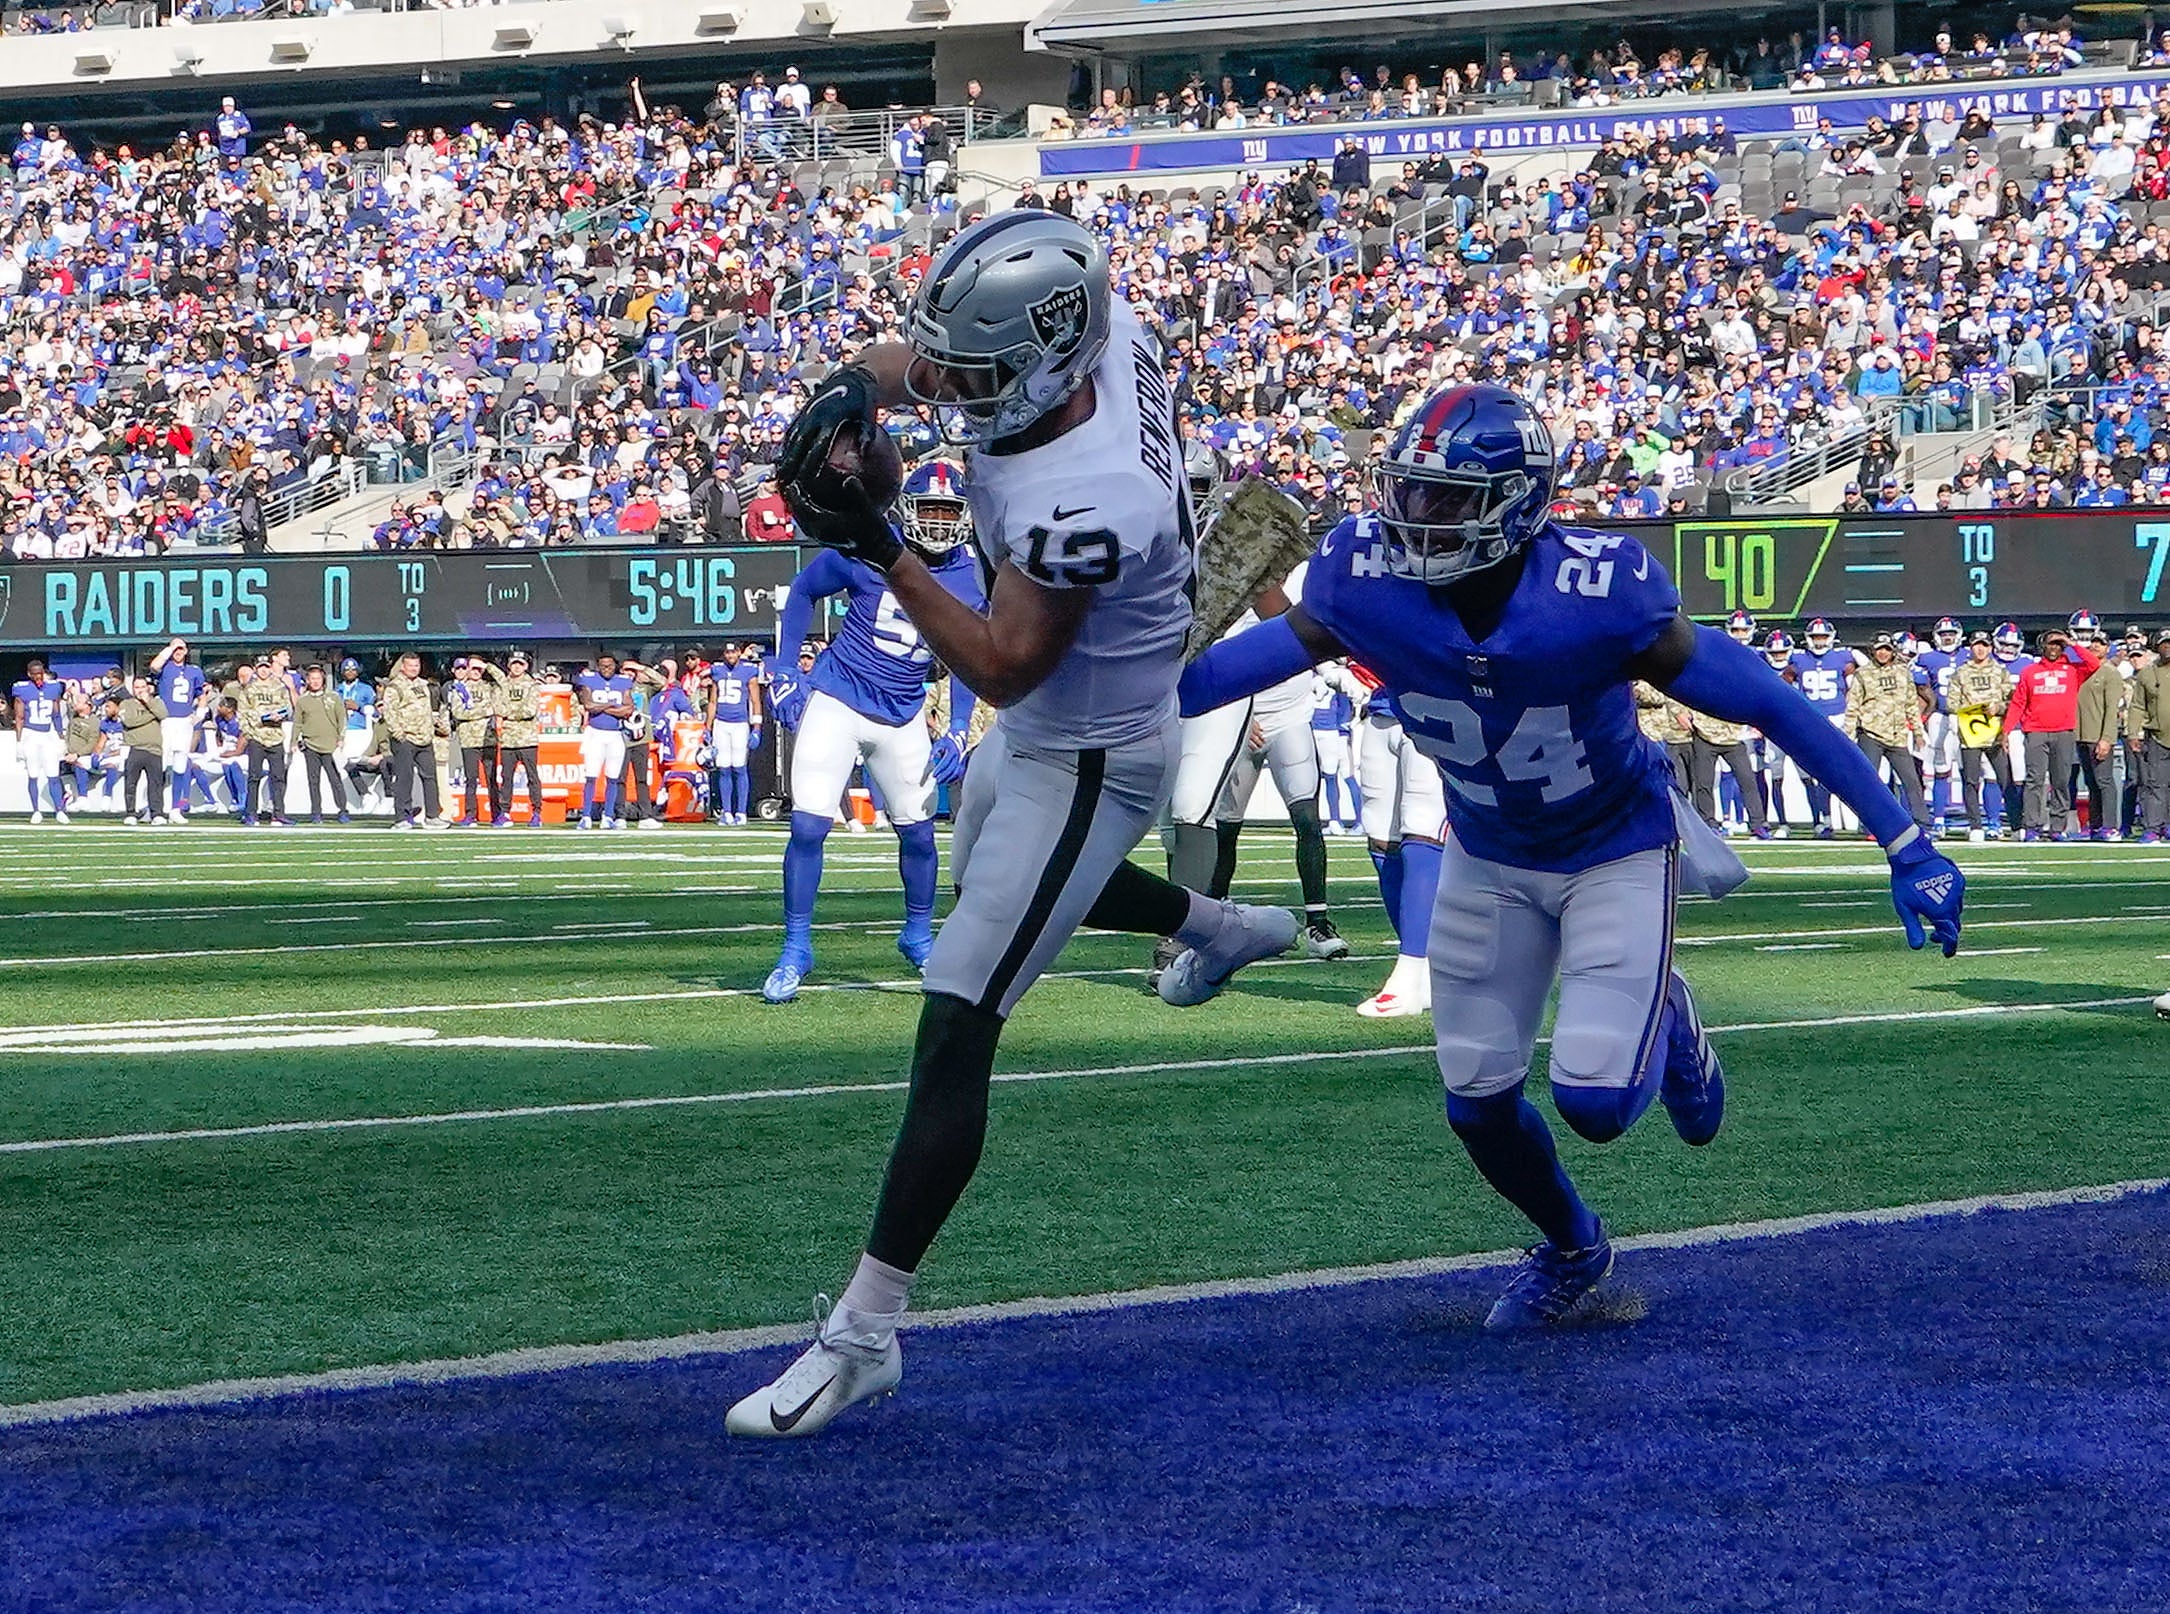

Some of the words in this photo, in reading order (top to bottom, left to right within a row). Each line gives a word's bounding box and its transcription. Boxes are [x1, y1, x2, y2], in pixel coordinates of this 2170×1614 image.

[1890, 100, 1945, 122] NW
[1959, 93, 2027, 118] YORK
[2042, 83, 2170, 111] FOOTBAL
[1398, 131, 1461, 153] YORK
[1475, 123, 1601, 148] FOOTBALL
[1036, 289, 1081, 315] RAIDERS
[1131, 339, 1172, 491] RENFROW
[1027, 525, 1120, 585] 13
[1958, 525, 1994, 563] TO
[2136, 523, 2170, 602] 7
[398, 563, 424, 594] TO
[1555, 535, 1624, 598] 24
[1705, 534, 1775, 611] 40
[45, 568, 268, 636] RAIDERS
[325, 567, 350, 632] 0
[630, 558, 735, 626] 5:46
[1970, 567, 1988, 607] 3
[406, 598, 419, 631] 3
[873, 590, 931, 662] 5
[172, 678, 190, 703] 2
[718, 679, 742, 704] 15
[1802, 670, 1838, 700] 95
[28, 700, 53, 724] 12
[1398, 691, 1595, 807] 24
[1915, 872, 1953, 890] adidas
